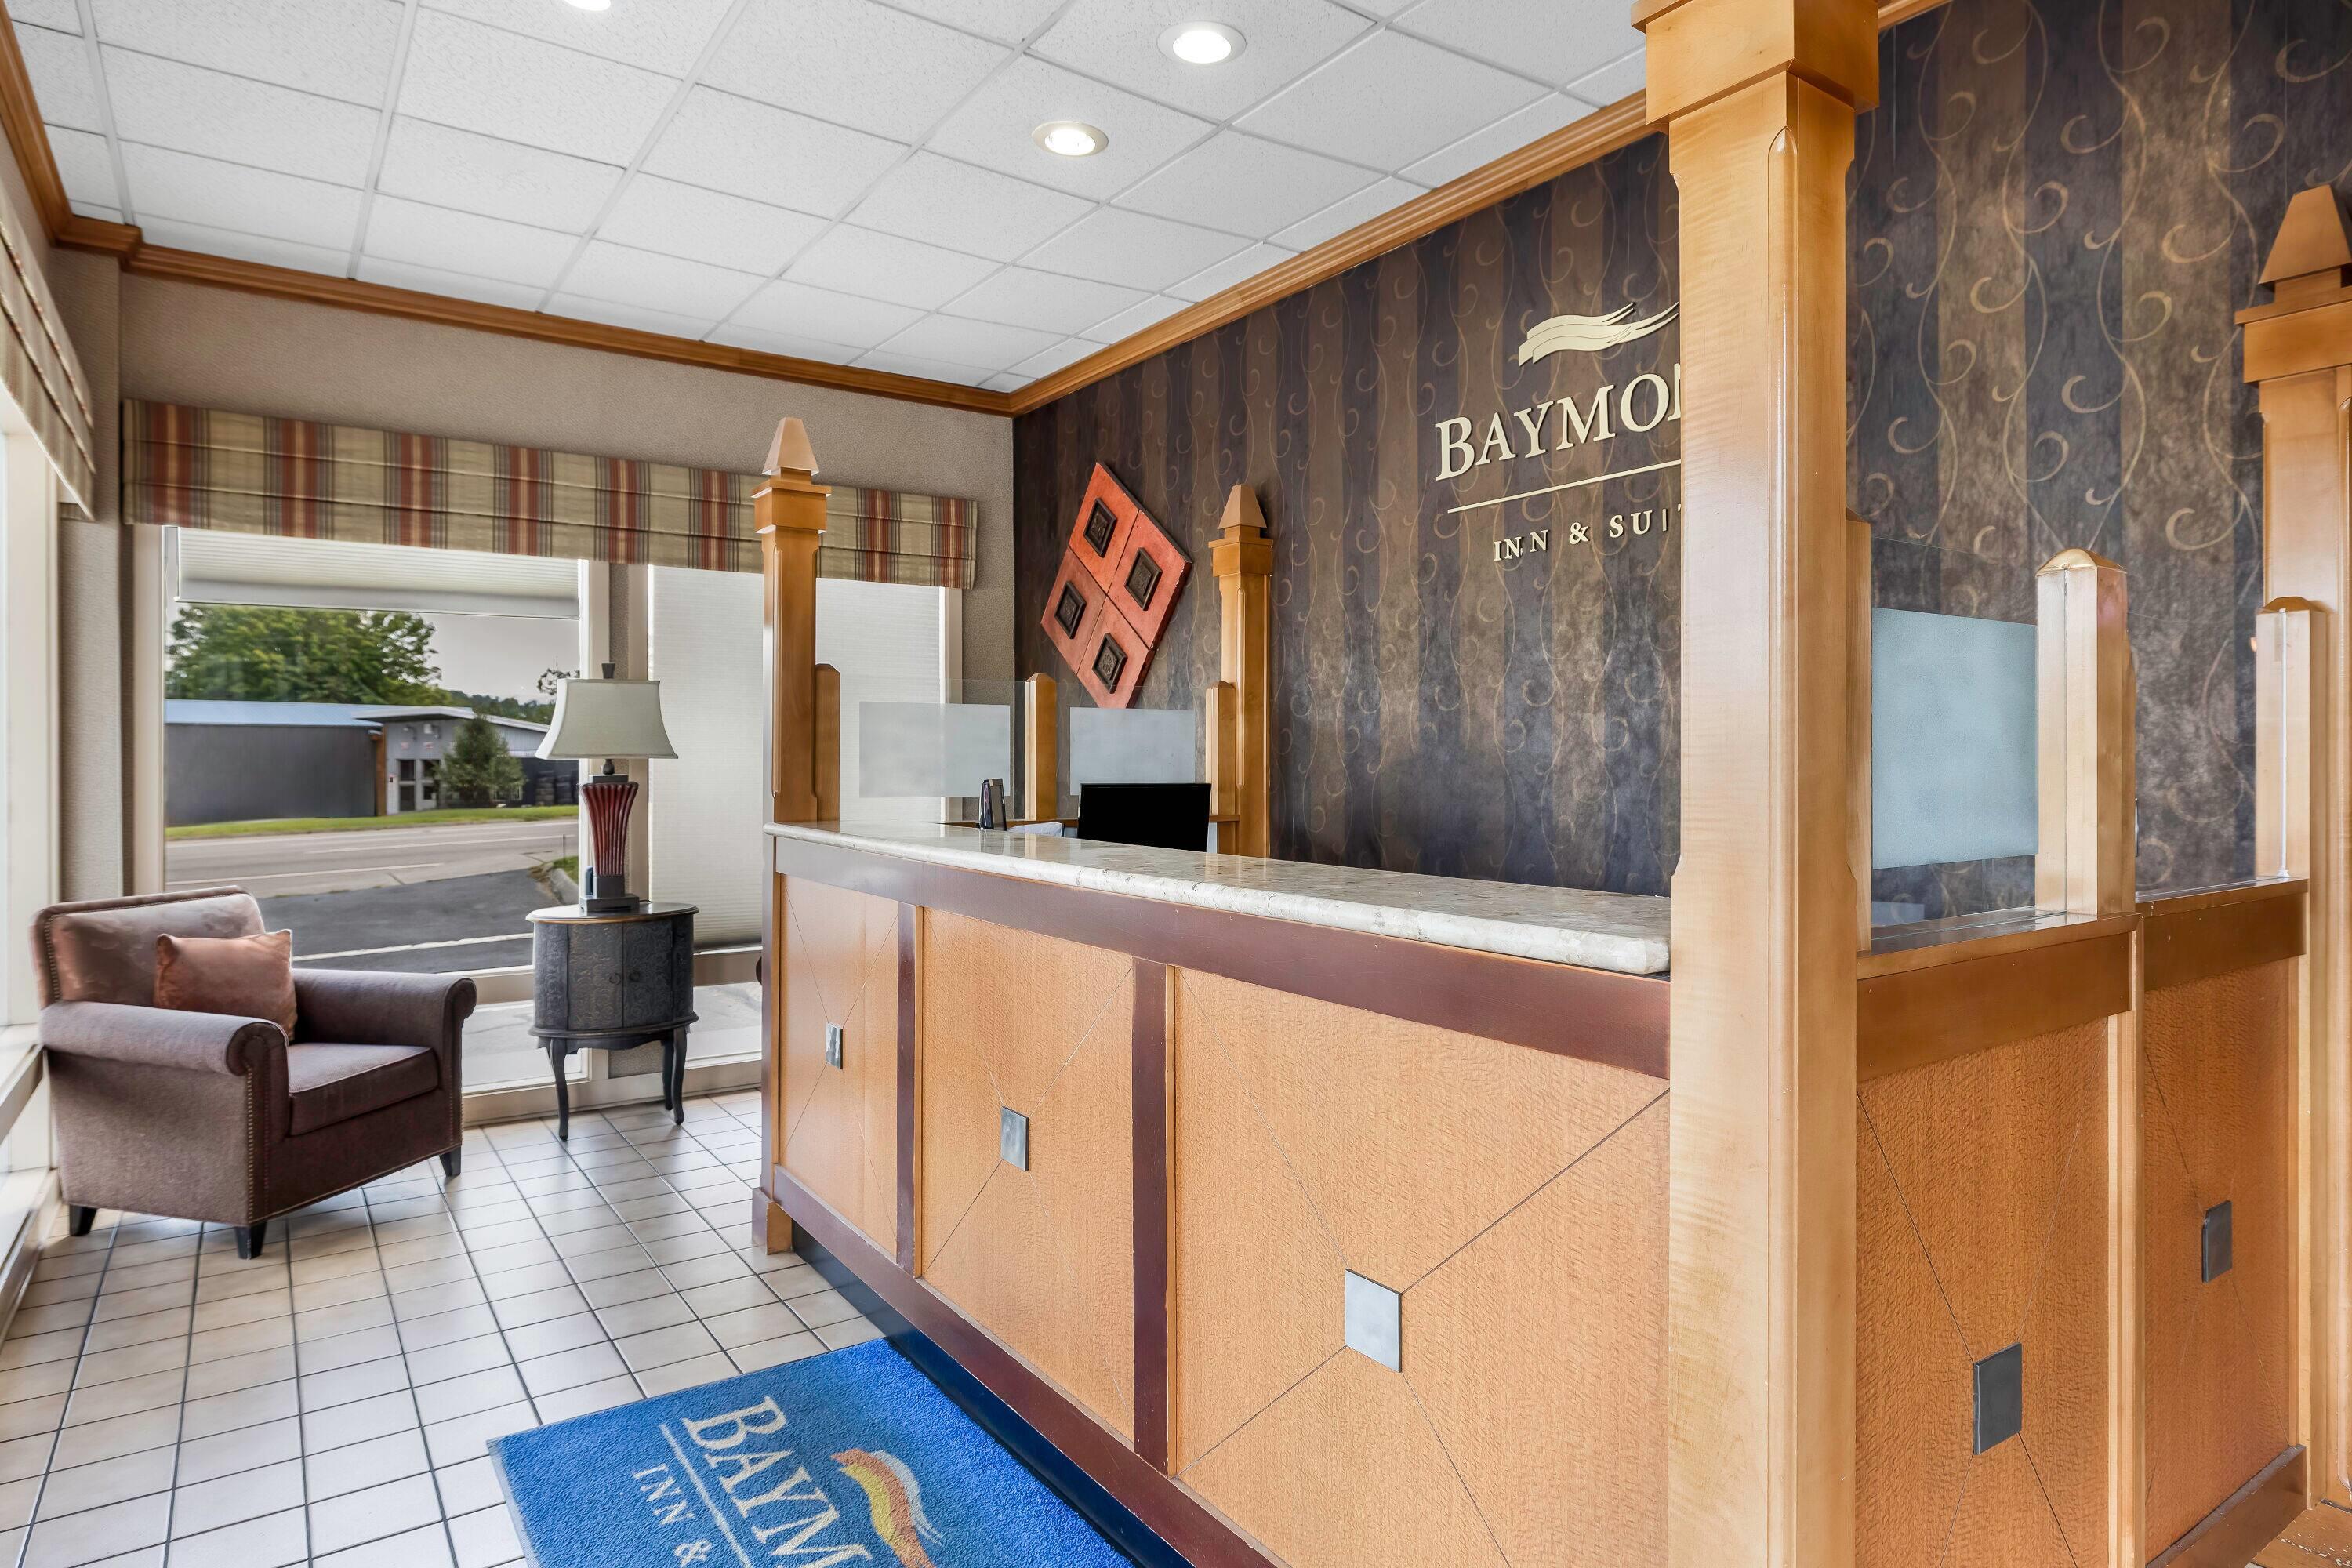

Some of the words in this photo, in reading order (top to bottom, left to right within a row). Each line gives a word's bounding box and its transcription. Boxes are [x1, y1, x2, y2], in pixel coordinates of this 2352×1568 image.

[1494, 530, 1549, 561] INN
[1569, 522, 1589, 544] &
[1609, 504, 1681, 538] SUI
[633, 1463, 695, 1525] INN
[673, 1539, 712, 1567] &
